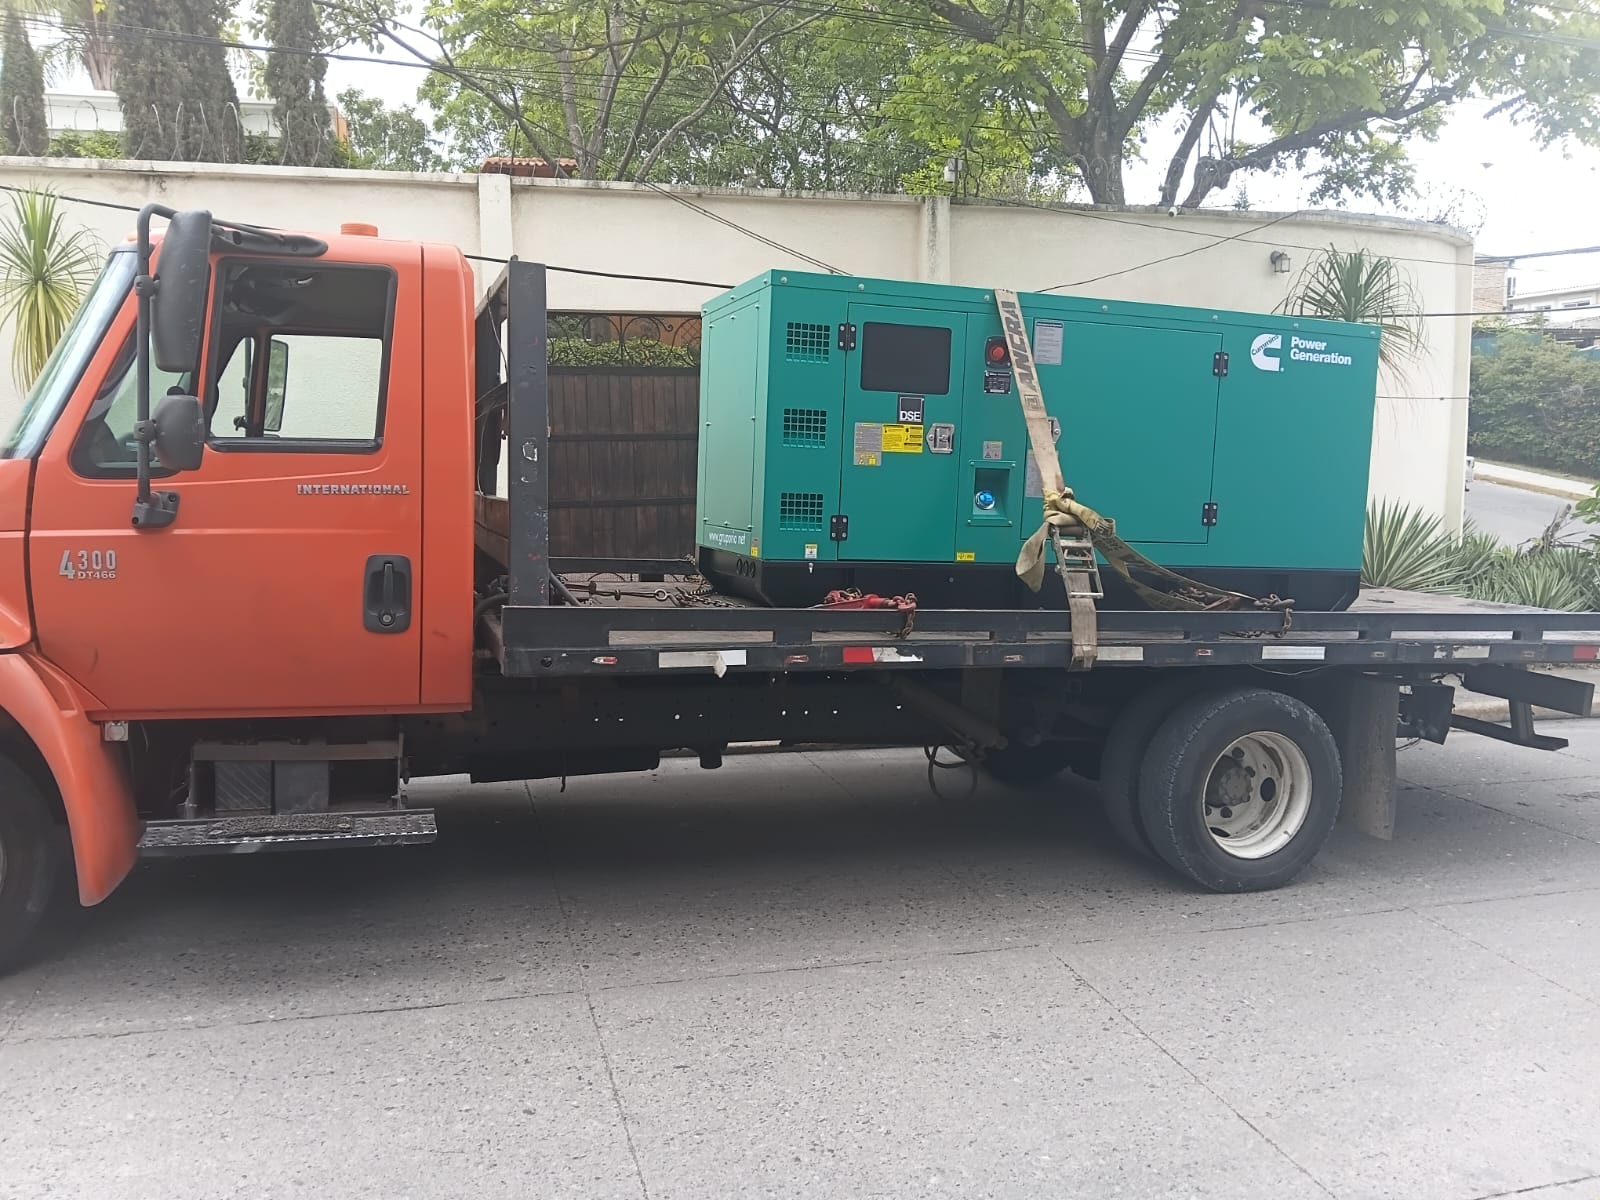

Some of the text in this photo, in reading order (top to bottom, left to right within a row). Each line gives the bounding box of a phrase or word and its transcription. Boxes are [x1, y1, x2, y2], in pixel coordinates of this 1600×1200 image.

[1251, 335, 1279, 356] Cummins
[1291, 336, 1327, 350] Power
[1290, 349, 1352, 365] Generation
[899, 410, 921, 421] DSE
[296, 484, 411, 496] INTERNATIONAL
[58, 549, 117, 580] 4300
[77, 570, 117, 580] DT466
